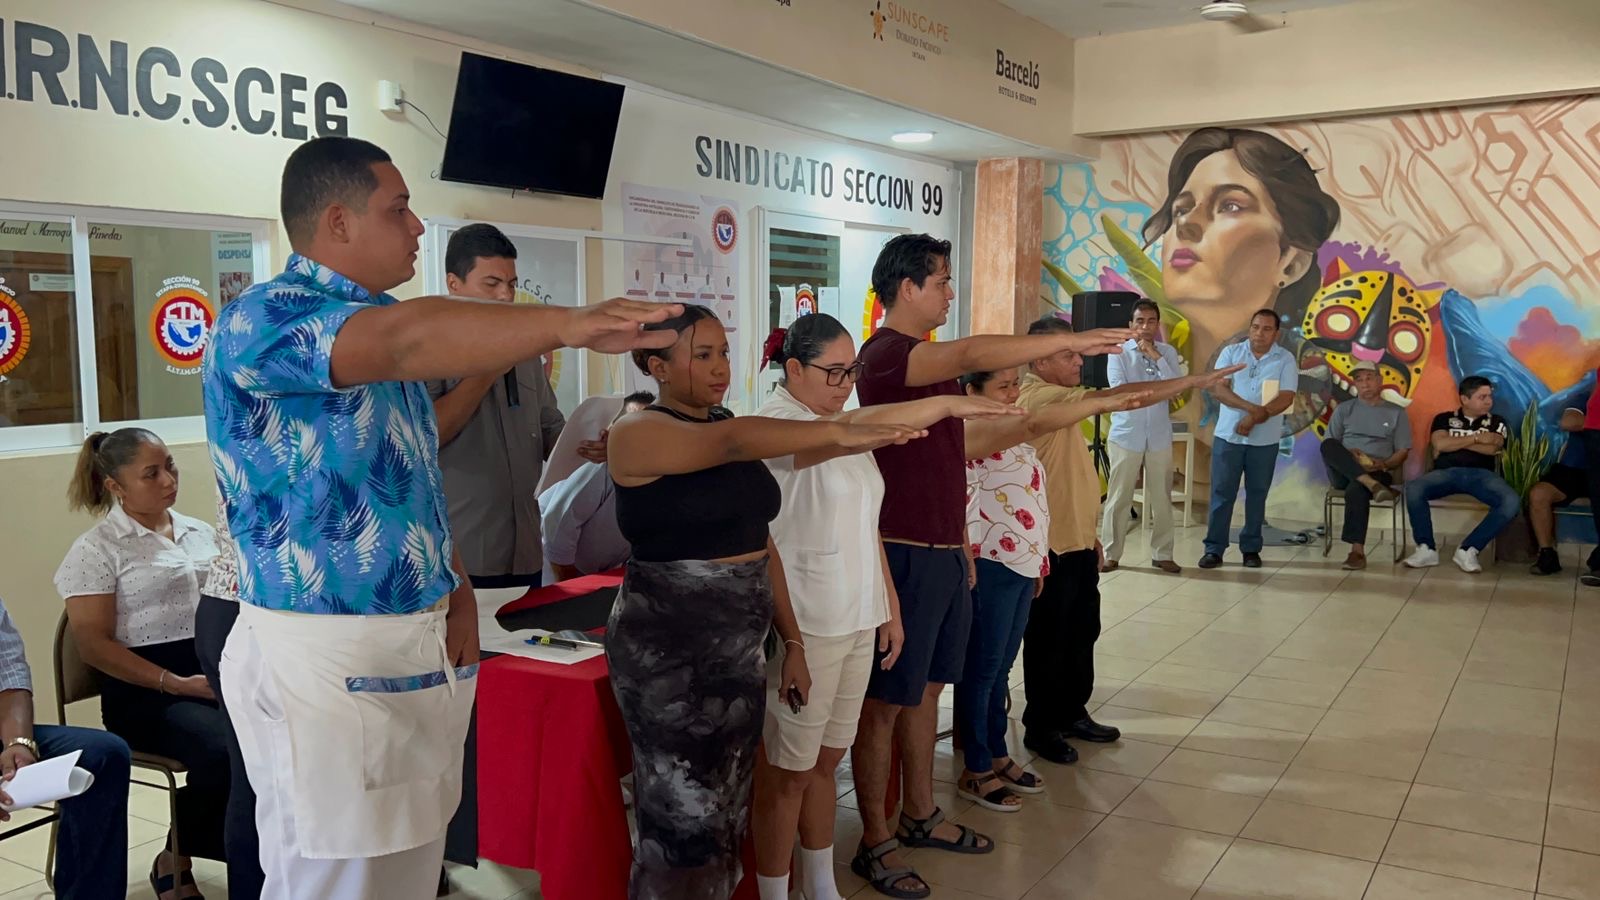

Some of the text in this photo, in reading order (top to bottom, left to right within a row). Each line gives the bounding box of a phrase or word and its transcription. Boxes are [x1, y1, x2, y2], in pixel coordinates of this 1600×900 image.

[887, 2, 949, 42] SUNSCAPE
[995, 48, 1040, 90] Barceló
[695, 135, 943, 216] SINDICATO SECCION 99
[162, 275, 191, 286] SECCIÓN
[165, 301, 205, 321] CTM
